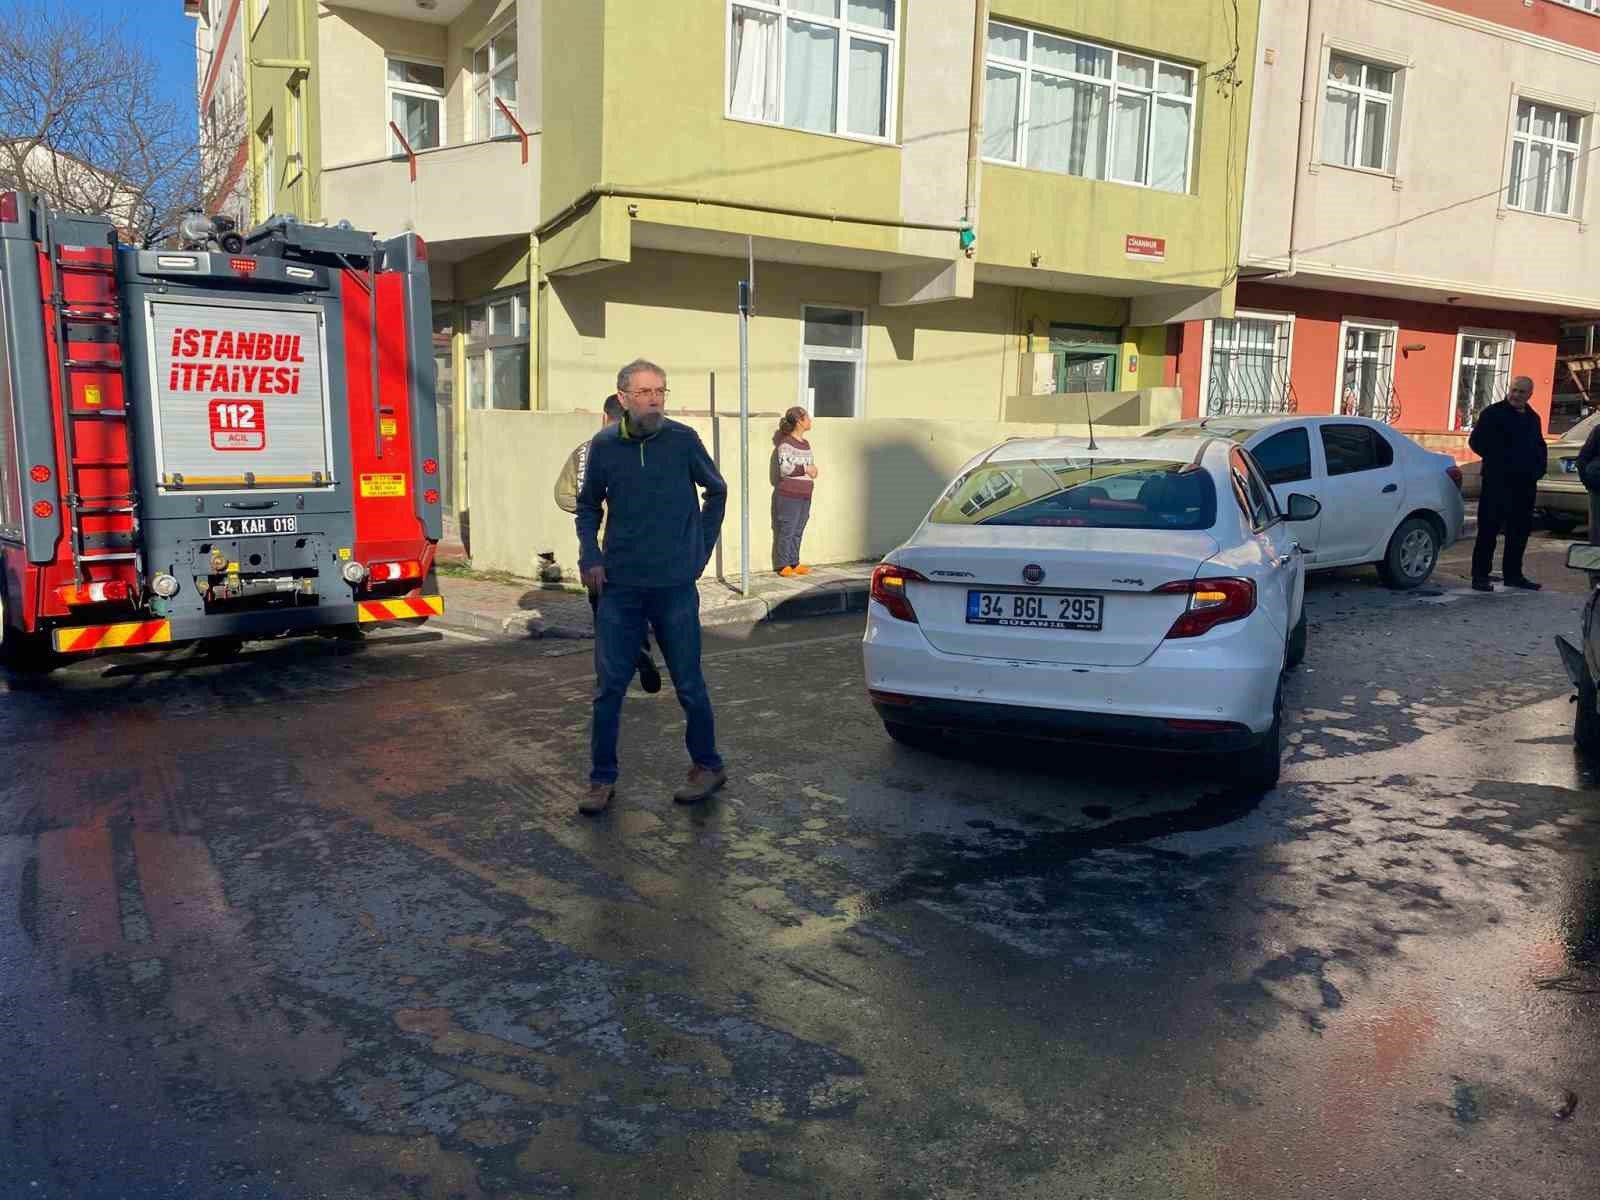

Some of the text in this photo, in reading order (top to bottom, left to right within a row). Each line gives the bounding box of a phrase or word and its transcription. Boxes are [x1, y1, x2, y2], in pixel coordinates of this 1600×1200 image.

[216, 404, 256, 428] 112
[217, 518, 295, 534] 34 KAH 018
[981, 595, 1003, 616] 34
[1013, 597, 1048, 618] BGL
[1059, 599, 1096, 620] 295
